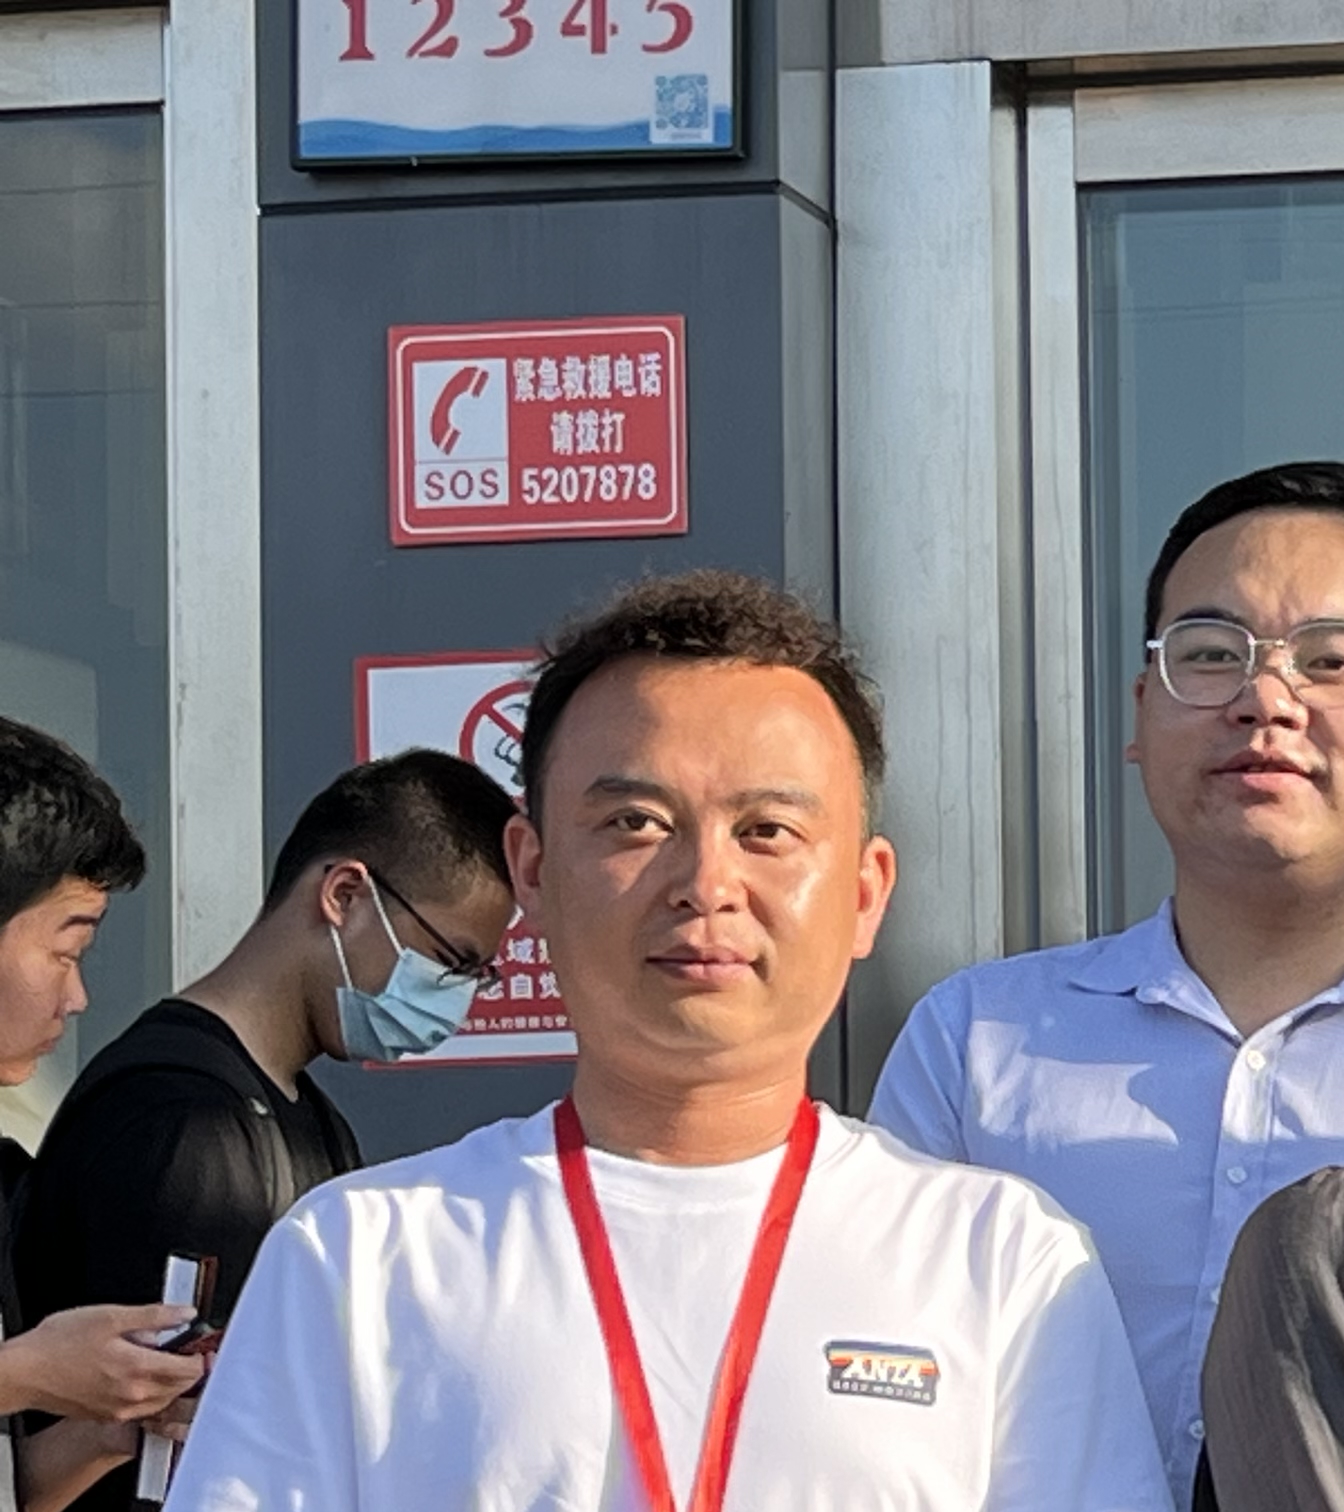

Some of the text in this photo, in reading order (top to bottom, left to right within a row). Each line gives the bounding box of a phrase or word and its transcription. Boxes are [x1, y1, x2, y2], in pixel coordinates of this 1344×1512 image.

[339, 0, 693, 61] 12345
[513, 352, 662, 401] 紧急救援电话
[550, 408, 625, 455] 请拨打
[425, 468, 499, 501] SOS
[521, 462, 657, 505] 5207878
[841, 1354, 925, 1388] ANTA
